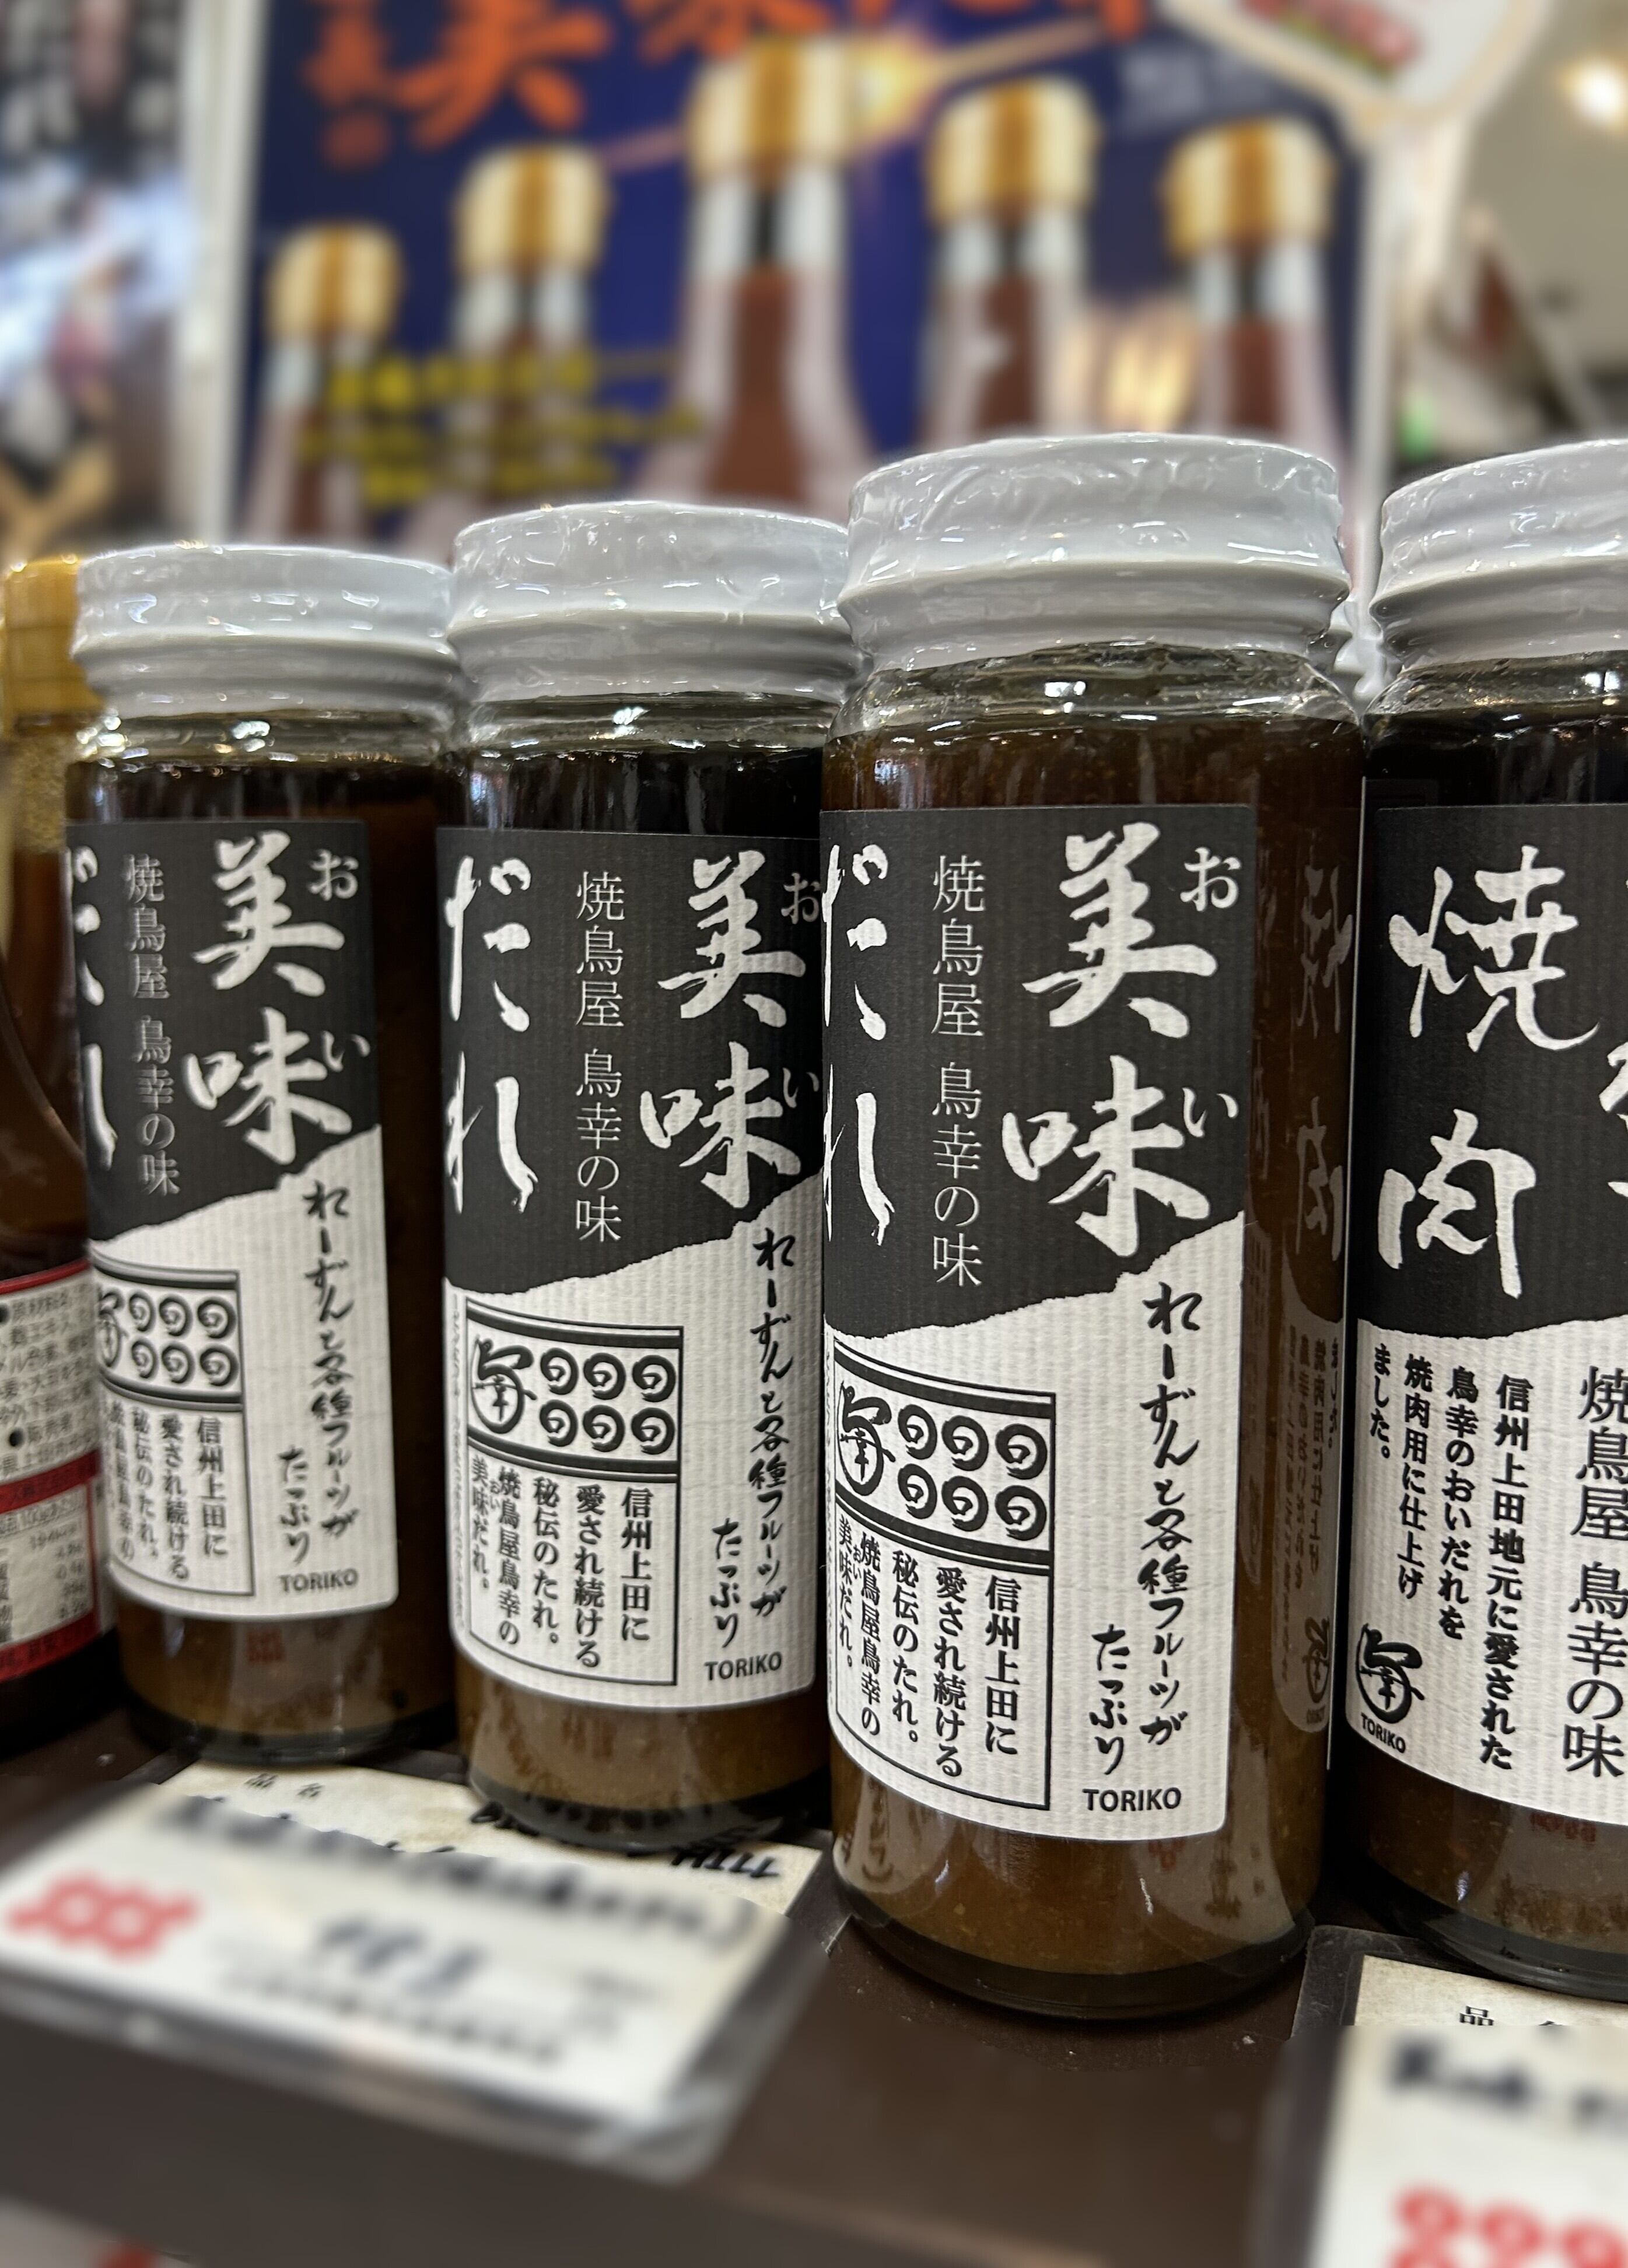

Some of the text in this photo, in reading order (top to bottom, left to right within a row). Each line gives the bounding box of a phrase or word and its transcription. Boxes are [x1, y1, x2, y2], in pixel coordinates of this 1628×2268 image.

[125, 853, 180, 1196] 焼鳥屋 鳥幸の味
[181, 830, 353, 1165] 美味
[445, 856, 538, 1214] だれ
[575, 871, 625, 1243] 焼鳥屋 鳥幸の味
[640, 849, 807, 1208] 美味
[931, 854, 985, 1288] 焼鳥屋 鳥幸の味
[1002, 821, 1217, 1257] 美味
[1378, 845, 1600, 1299] 焼肉
[197, 1416, 228, 1557] 信州上田に
[1370, 1342, 1391, 1460] ました。
[1397, 1353, 1433, 1600] 焼肉用に仕上げ
[279, 1568, 359, 1592] TORIKO
[533, 1475, 559, 1643] 秘伝のたれ。
[574, 1483, 605, 1668] 愛され続ける
[621, 1487, 653, 1642] 信州上田に
[710, 1518, 741, 1649] たっぷり
[1438, 1366, 1479, 1640] 鳥幸のおいだれを
[1480, 1374, 1534, 1770] 信州上田地元に愛された
[1562, 1365, 1628, 1778] 焼鳥屋 鳥幸の味
[705, 1650, 782, 1681] TORIKO
[892, 1550, 919, 1742] 秘伝のたれ。
[933, 1565, 967, 1778] 愛され続ける
[984, 1575, 1022, 1755] 信州上田に
[1088, 1624, 1131, 1775] たっぷり
[1360, 1712, 1406, 1754] TORIKO
[1082, 1786, 1182, 1813] TORIKO
